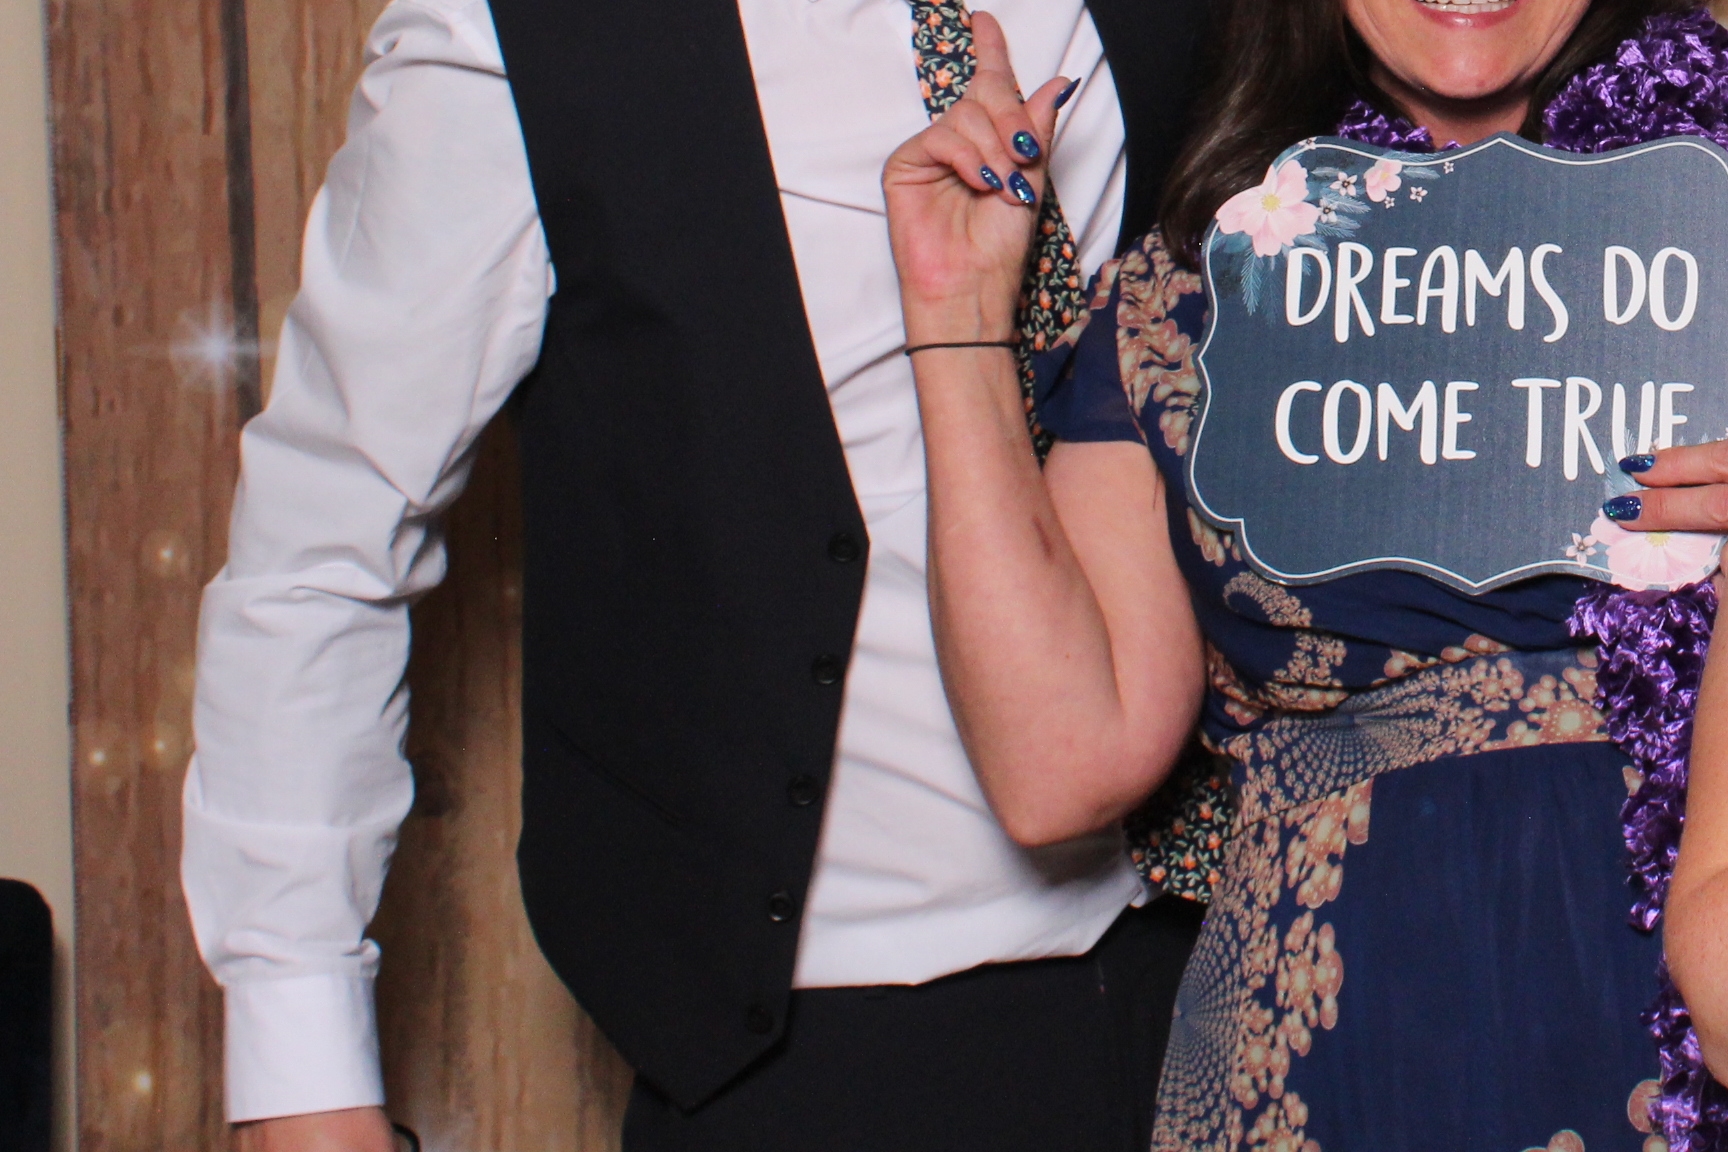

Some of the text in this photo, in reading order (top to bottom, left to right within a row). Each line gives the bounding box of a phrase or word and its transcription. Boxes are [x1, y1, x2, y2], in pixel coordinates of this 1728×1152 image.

[1283, 241, 1699, 343] DREAMS DO
[1274, 379, 1480, 465] COME
